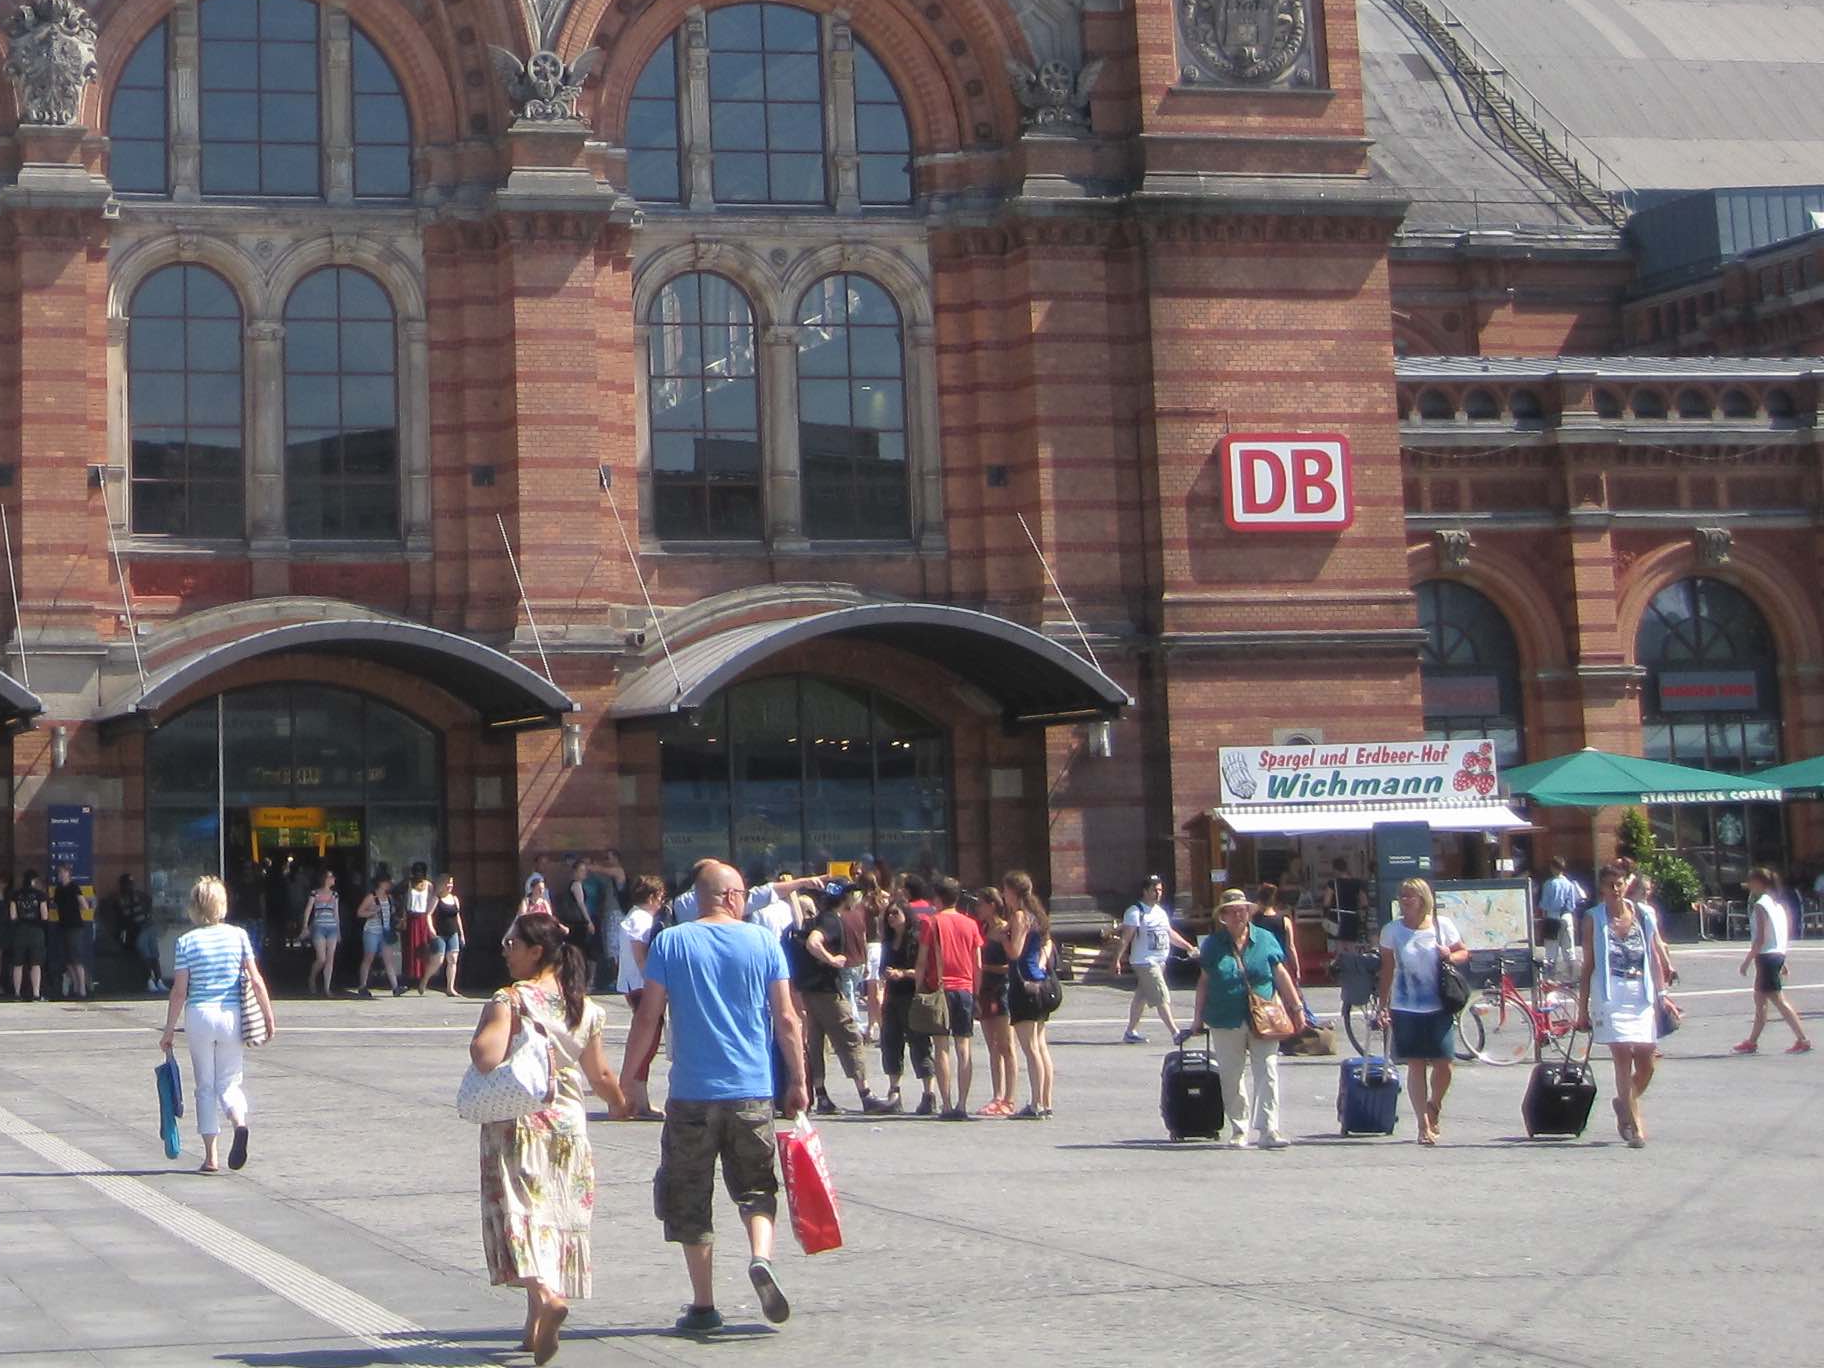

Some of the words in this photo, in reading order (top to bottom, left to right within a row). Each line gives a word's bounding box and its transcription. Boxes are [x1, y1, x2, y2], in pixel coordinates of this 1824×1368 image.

[1239, 449, 1338, 514] DB
[1258, 748, 1315, 771] Spargel
[1320, 748, 1348, 767] und
[1355, 743, 1450, 765] Erdbeer-Hof
[1267, 770, 1444, 800] Wichmann
[1640, 791, 1725, 804] STARBUCKS
